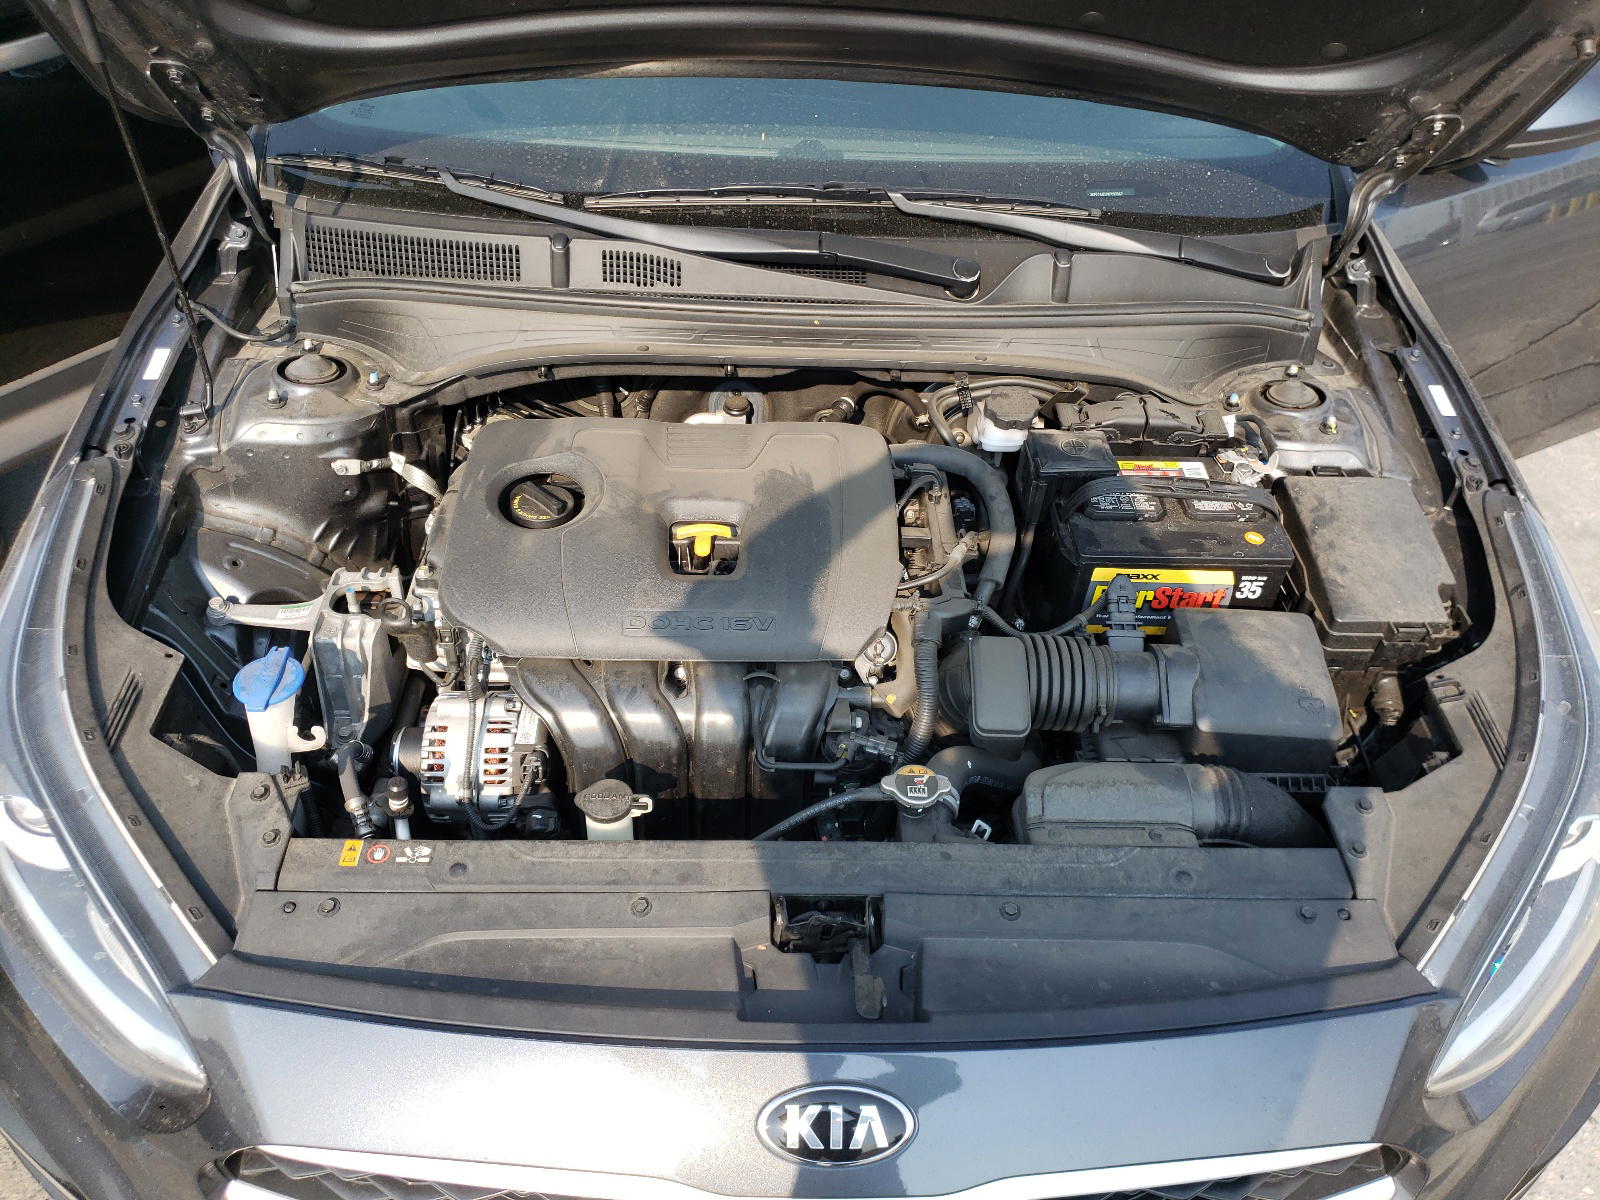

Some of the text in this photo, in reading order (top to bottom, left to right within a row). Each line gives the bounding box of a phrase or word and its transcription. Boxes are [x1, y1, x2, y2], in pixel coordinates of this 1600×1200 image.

[1091, 585, 1226, 609] rStart
[1235, 581, 1265, 599] 35
[625, 616, 775, 632] DOHC 16V
[584, 792, 633, 802] COOLANT
[785, 1104, 889, 1150] KIA
